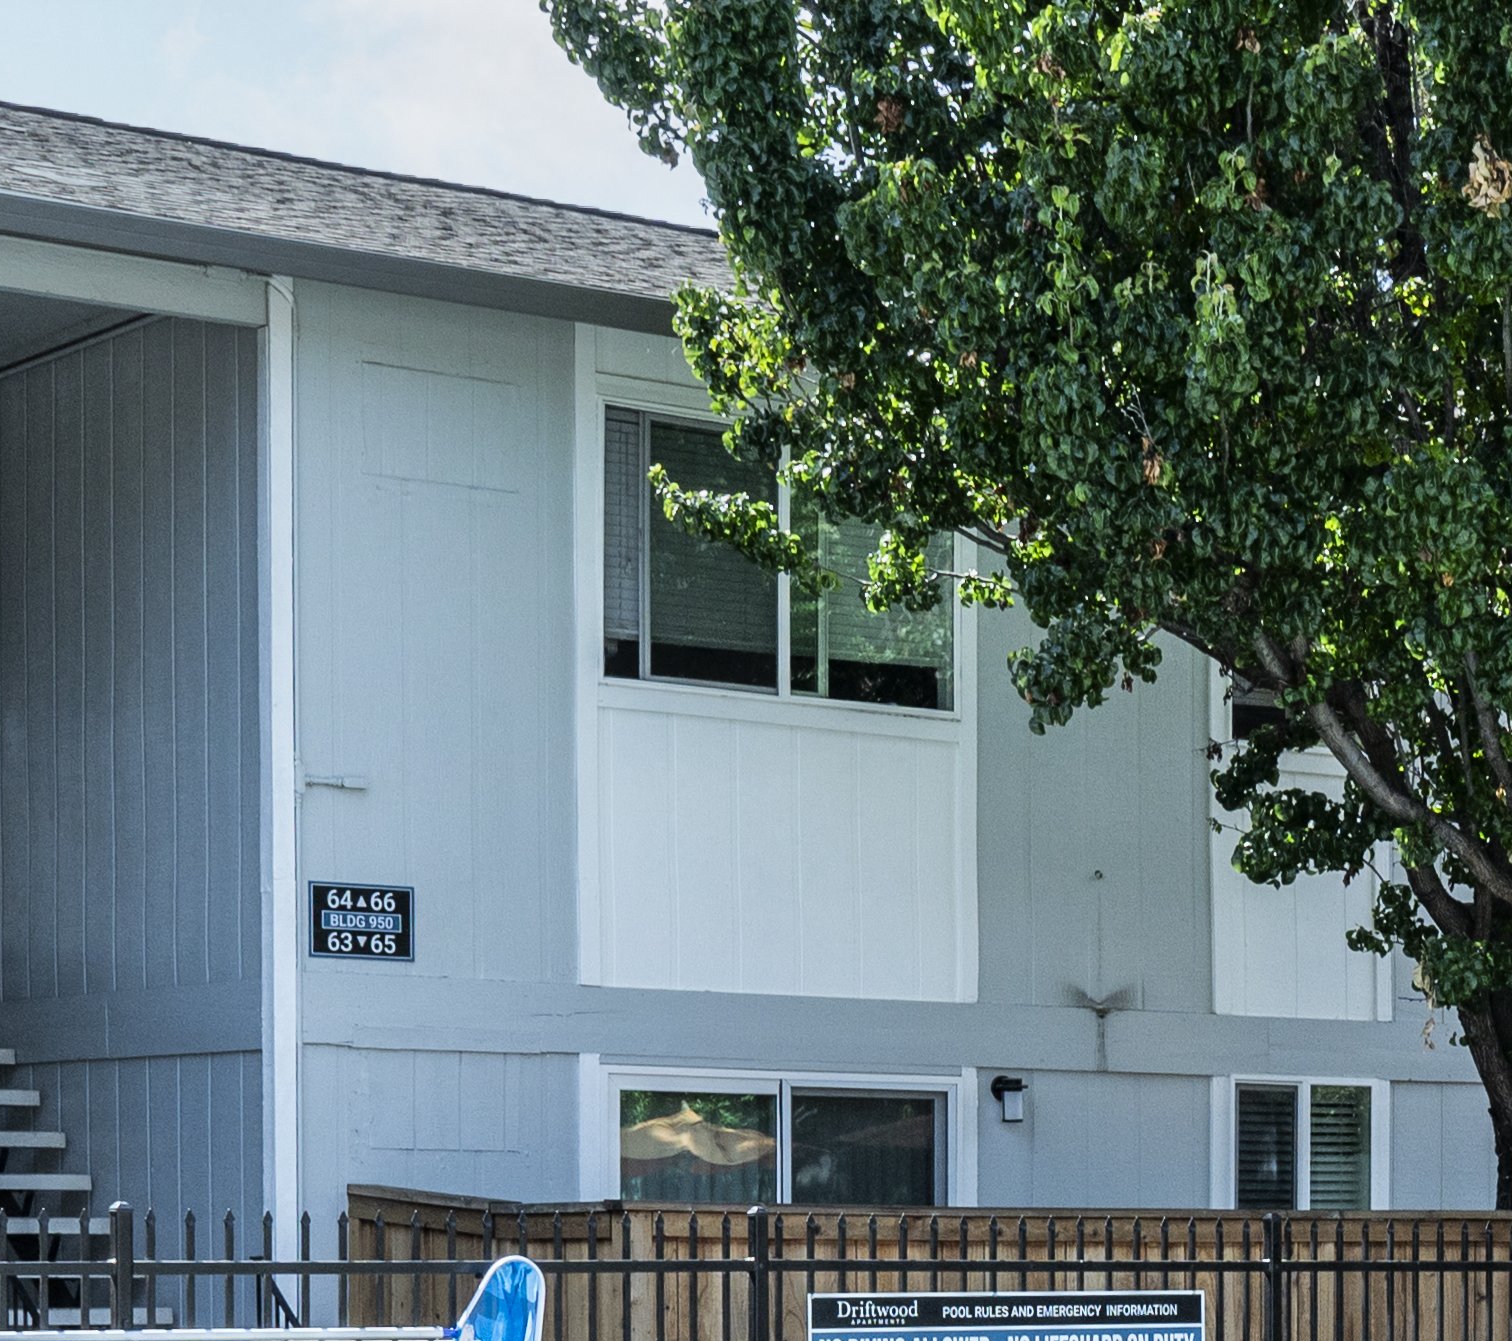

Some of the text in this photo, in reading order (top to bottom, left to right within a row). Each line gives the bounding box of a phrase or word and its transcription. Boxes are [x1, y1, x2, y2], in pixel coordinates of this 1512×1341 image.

[327, 889, 396, 912] 64 66
[330, 914, 393, 929] BLDG 950
[327, 932, 396, 954] 63 65
[837, 1300, 918, 1318] Driftwood
[943, 1304, 1178, 1318] POOL RULES AND EMERGENCY INFORMATION
